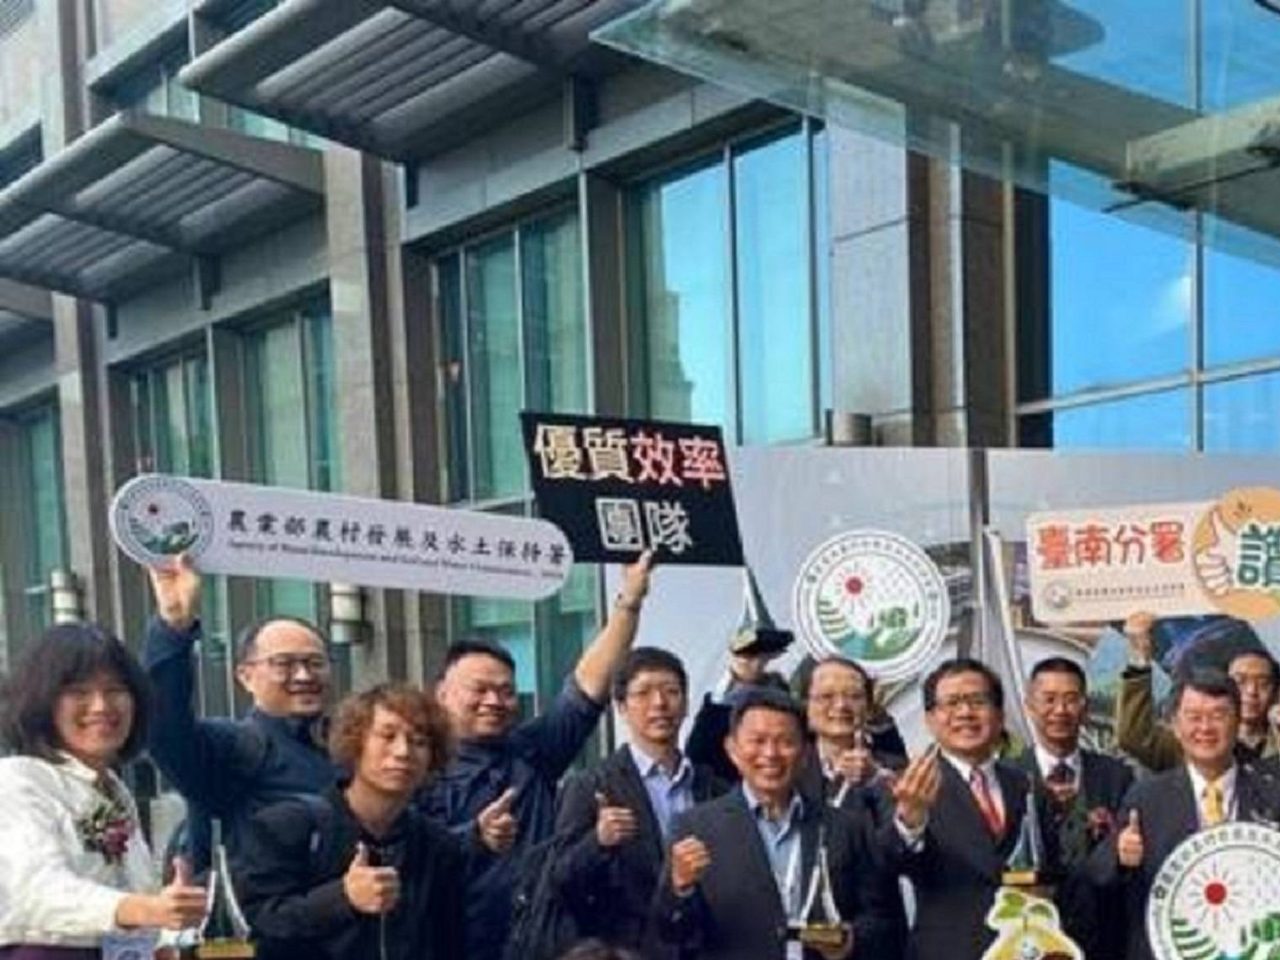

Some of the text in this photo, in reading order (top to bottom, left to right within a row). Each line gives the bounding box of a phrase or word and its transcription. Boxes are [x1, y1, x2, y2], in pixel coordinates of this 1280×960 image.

[534, 424, 726, 488] 優質效率
[595, 497, 693, 555] 團隊
[1037, 521, 1186, 569] 臺南分署
